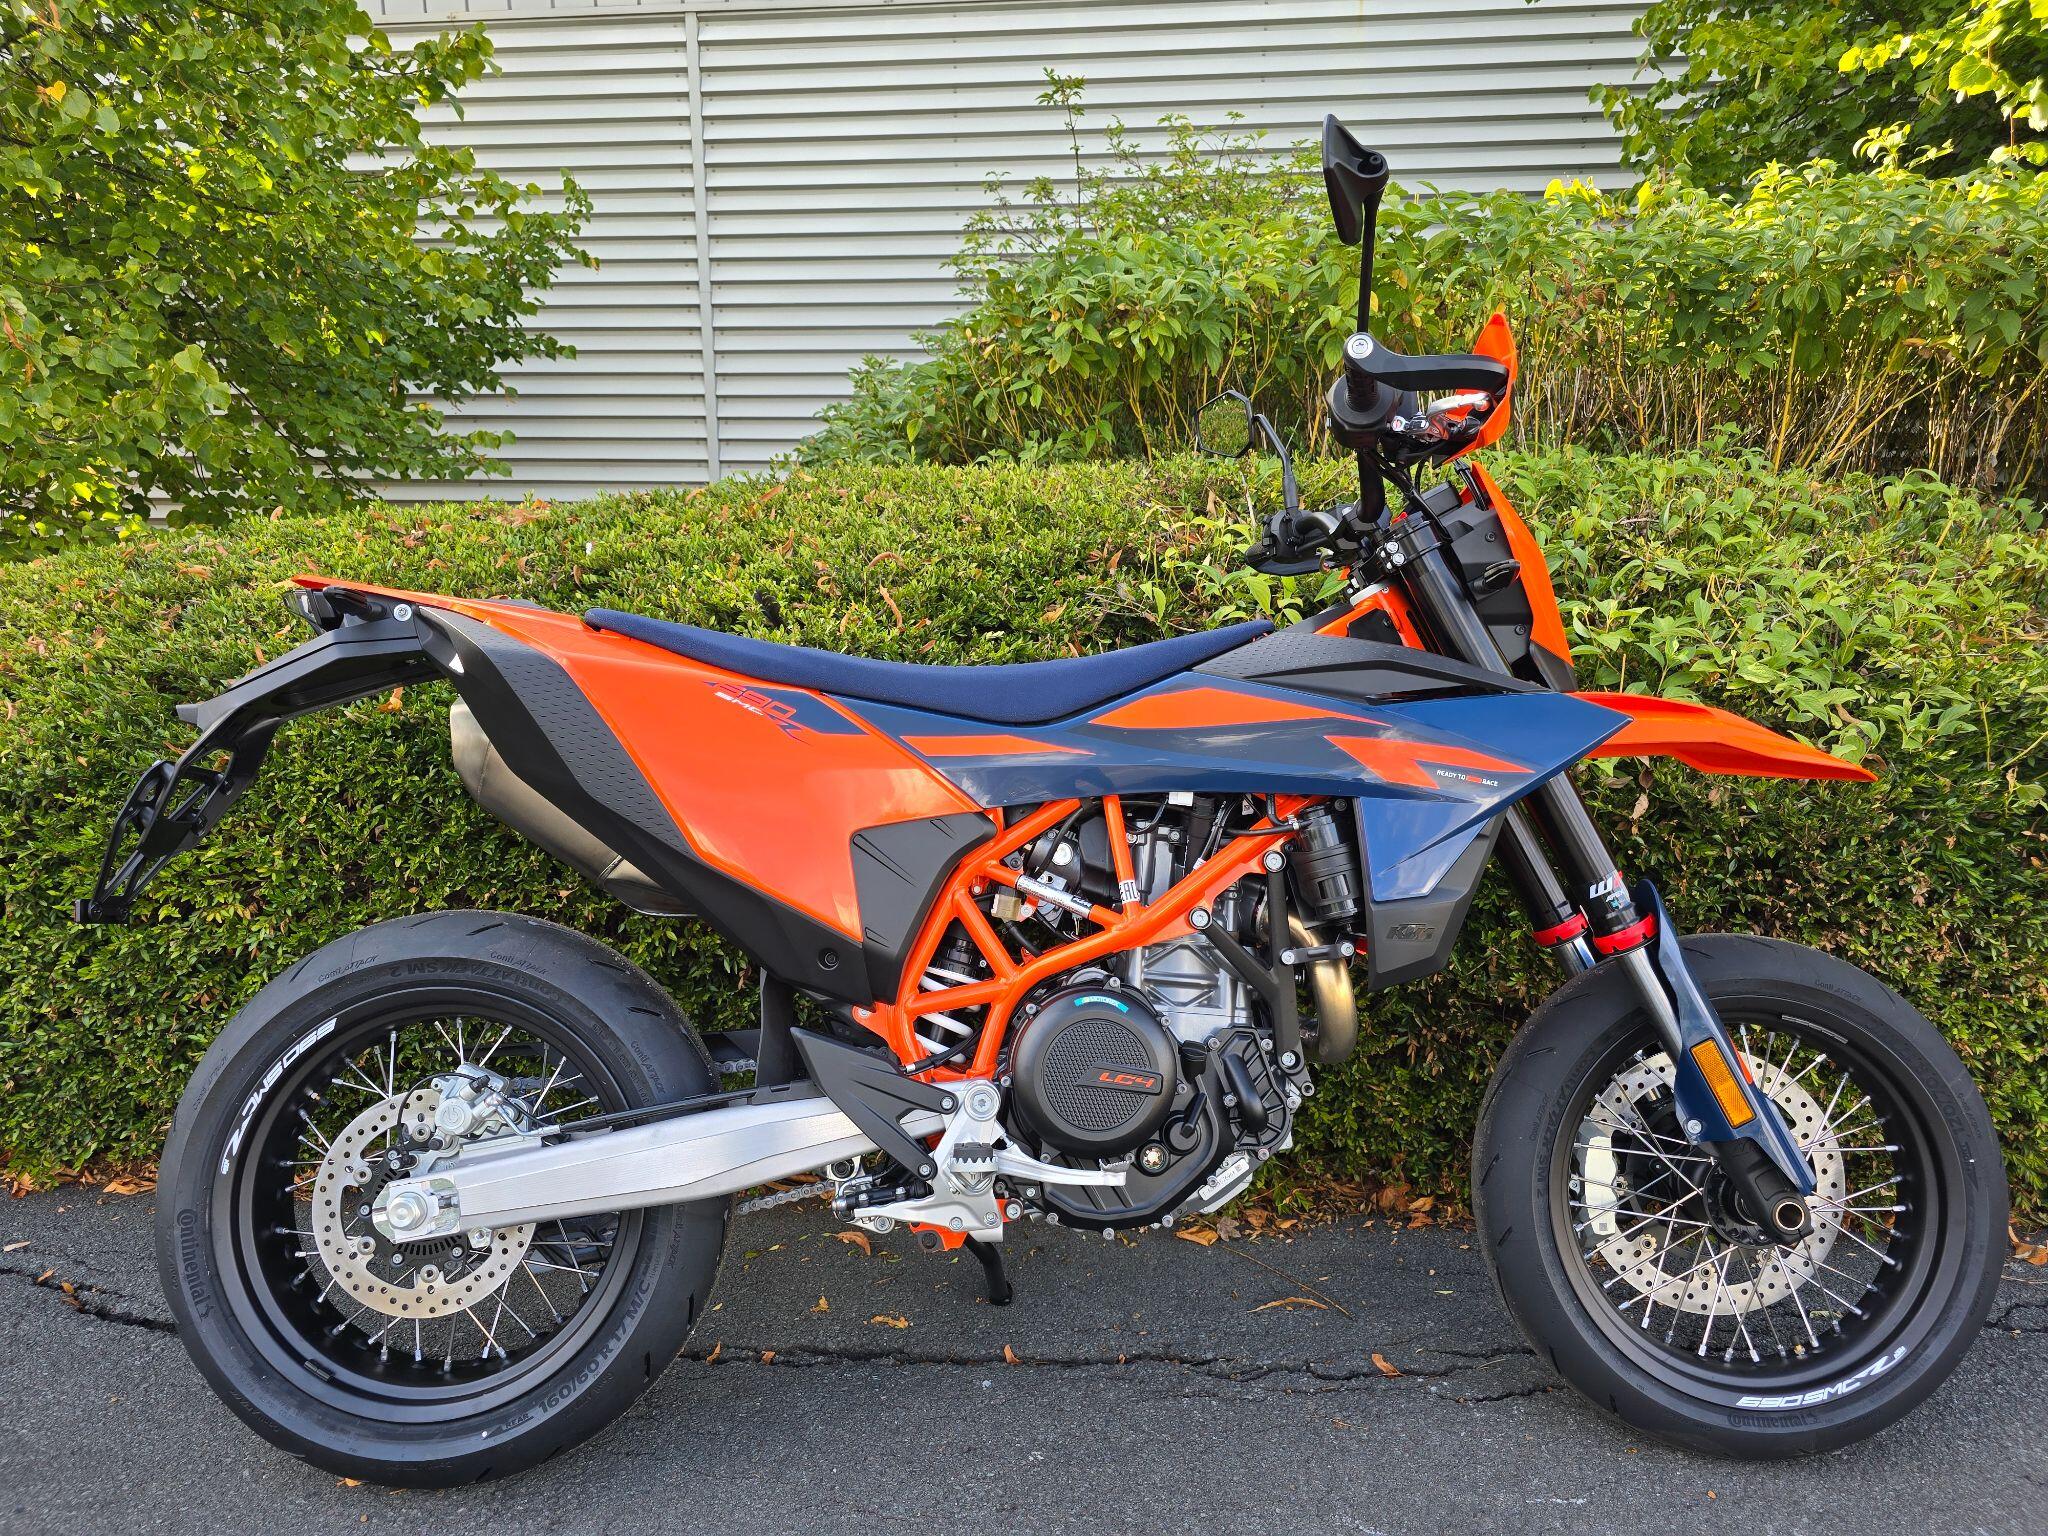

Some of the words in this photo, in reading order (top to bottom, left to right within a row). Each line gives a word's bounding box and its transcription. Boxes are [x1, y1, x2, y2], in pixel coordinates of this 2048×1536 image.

[1437, 769, 1456, 779] READY
[1457, 773, 1466, 781] TO
[1482, 778, 1498, 787] RACE
[1099, 1072, 1155, 1088] LC4
[177, 1209, 211, 1321] Continental
[538, 1359, 600, 1414] 160/60
[505, 1413, 529, 1429] REAR
[1727, 1413, 1808, 1428] Continental
